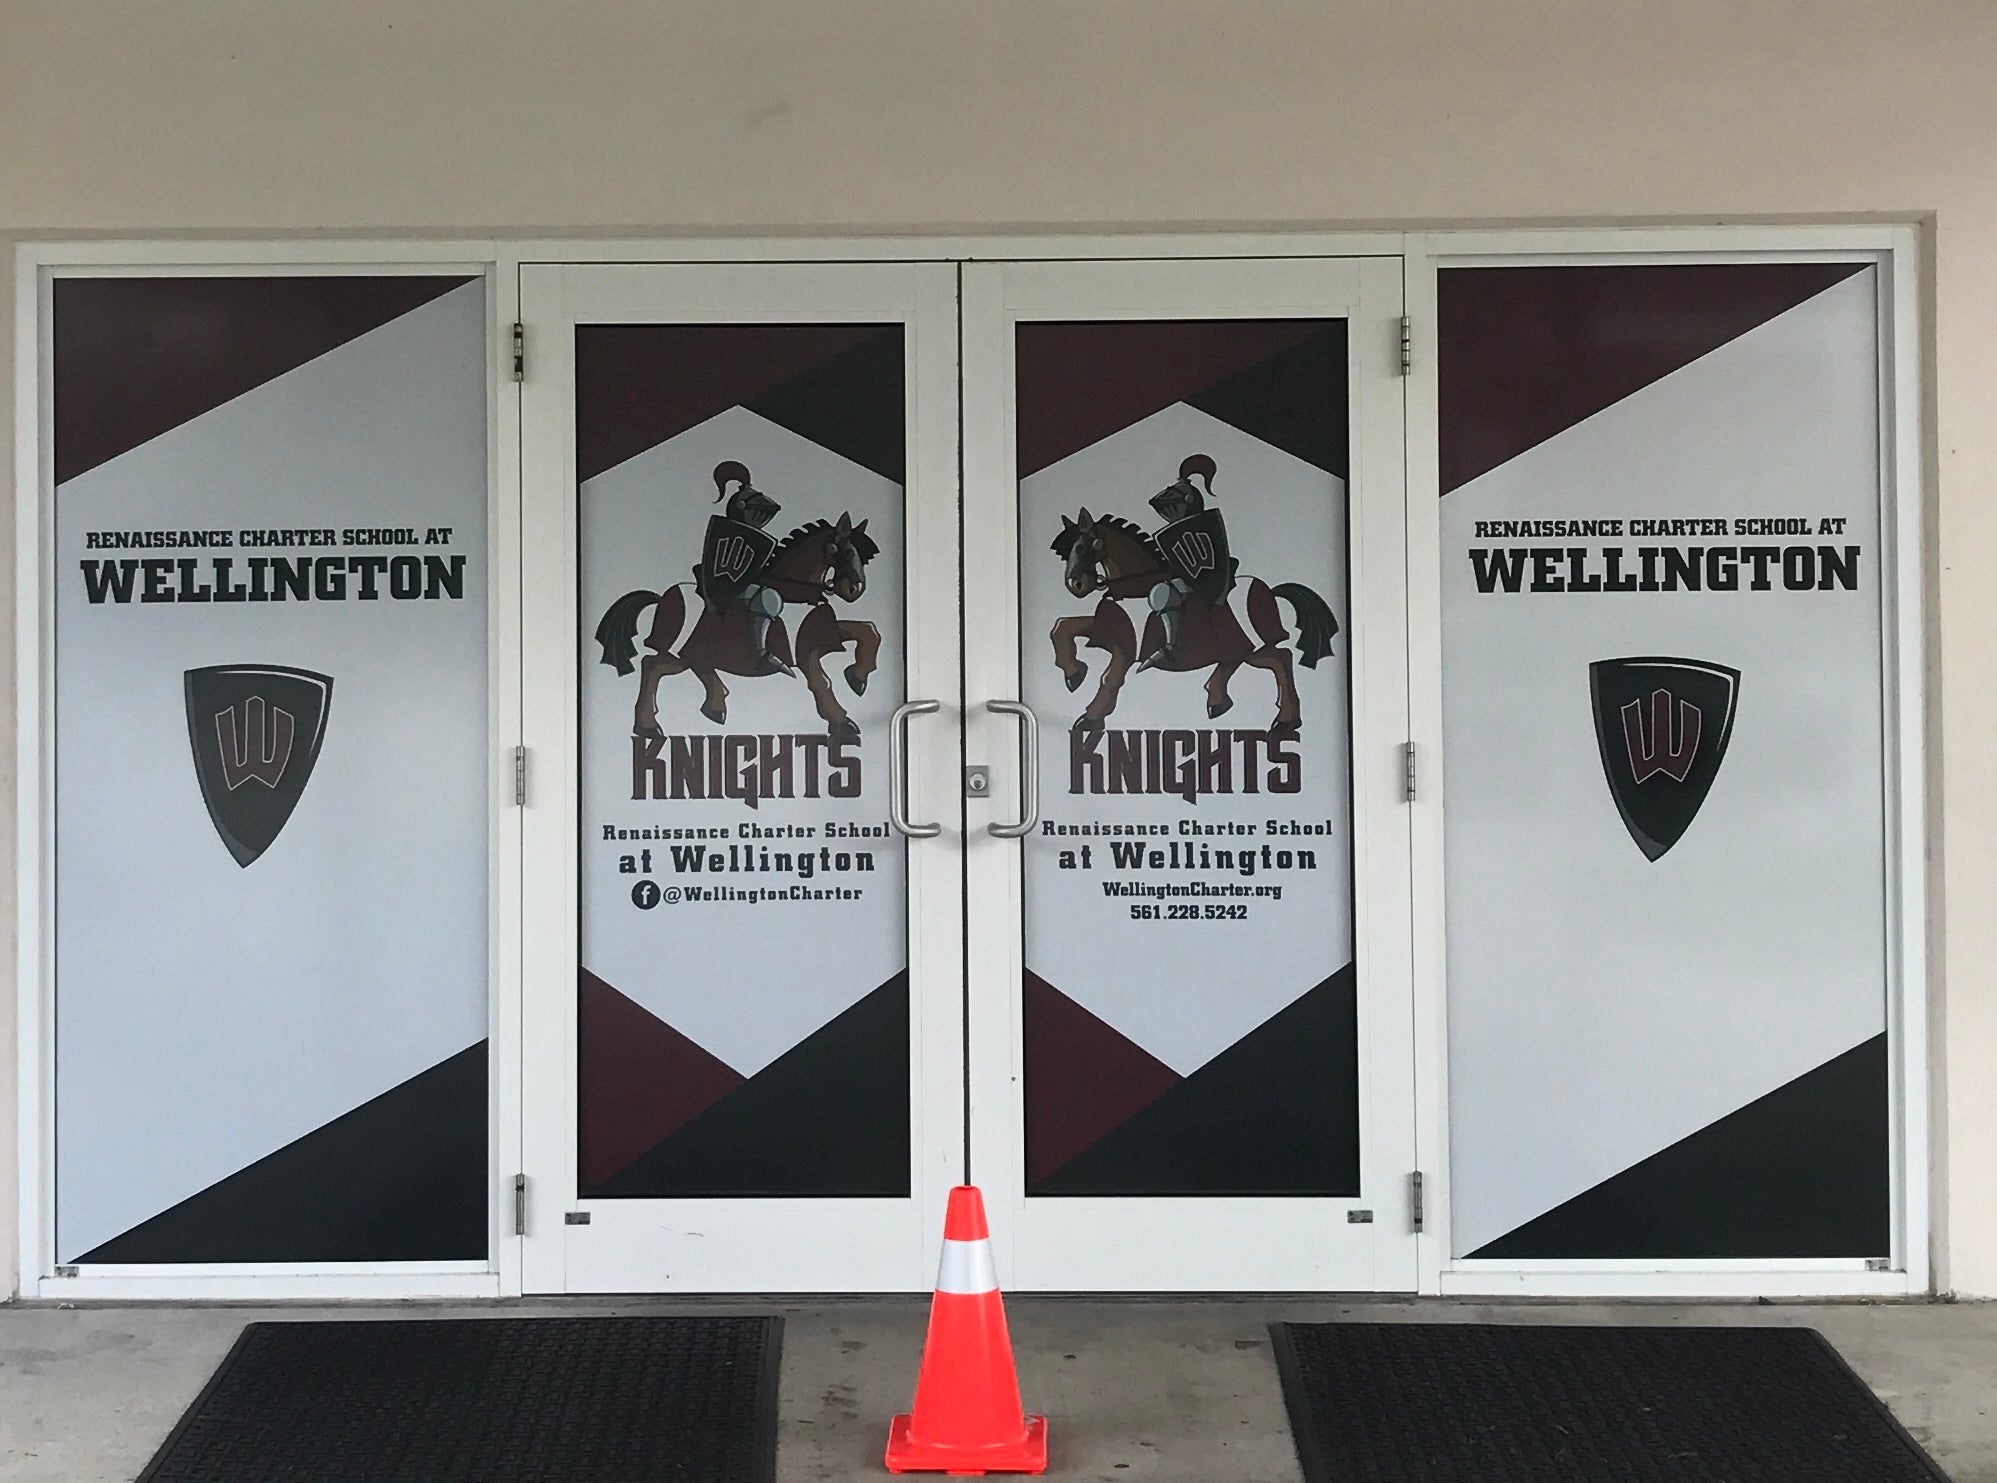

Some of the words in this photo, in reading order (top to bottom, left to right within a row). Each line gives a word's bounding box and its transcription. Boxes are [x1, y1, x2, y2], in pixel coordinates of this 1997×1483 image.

[86, 530, 234, 550] RENAISSANCE
[239, 529, 338, 548] CHARTER
[342, 528, 419, 546] SCHOOL
[424, 527, 453, 545] AT
[1474, 519, 1624, 538] RENAISSANCE
[1629, 518, 1729, 537] CHARTER
[1734, 518, 1813, 536] SCHOOL
[1817, 517, 1847, 535] AT
[79, 554, 467, 605] WELLINGTON
[1468, 545, 1861, 594] WELLINGTON
[630, 734, 862, 810] KNIGHTS
[1068, 729, 1303, 806] KNIGHTS
[602, 824, 730, 841] Renaissance
[738, 822, 817, 839] Charter
[825, 822, 891, 838] School
[1041, 820, 1170, 836] Renaissance
[1178, 819, 1257, 836] Charter
[1265, 819, 1333, 836] School
[619, 848, 652, 874] at
[670, 844, 875, 879] Wellington
[1058, 844, 1092, 870] at
[1109, 841, 1317, 877] Wellington
[662, 885, 863, 905] @WellingtonCharter
[1101, 881, 1283, 901] WellingtonCharter.org
[1130, 904, 1248, 920] 561.228.5242
